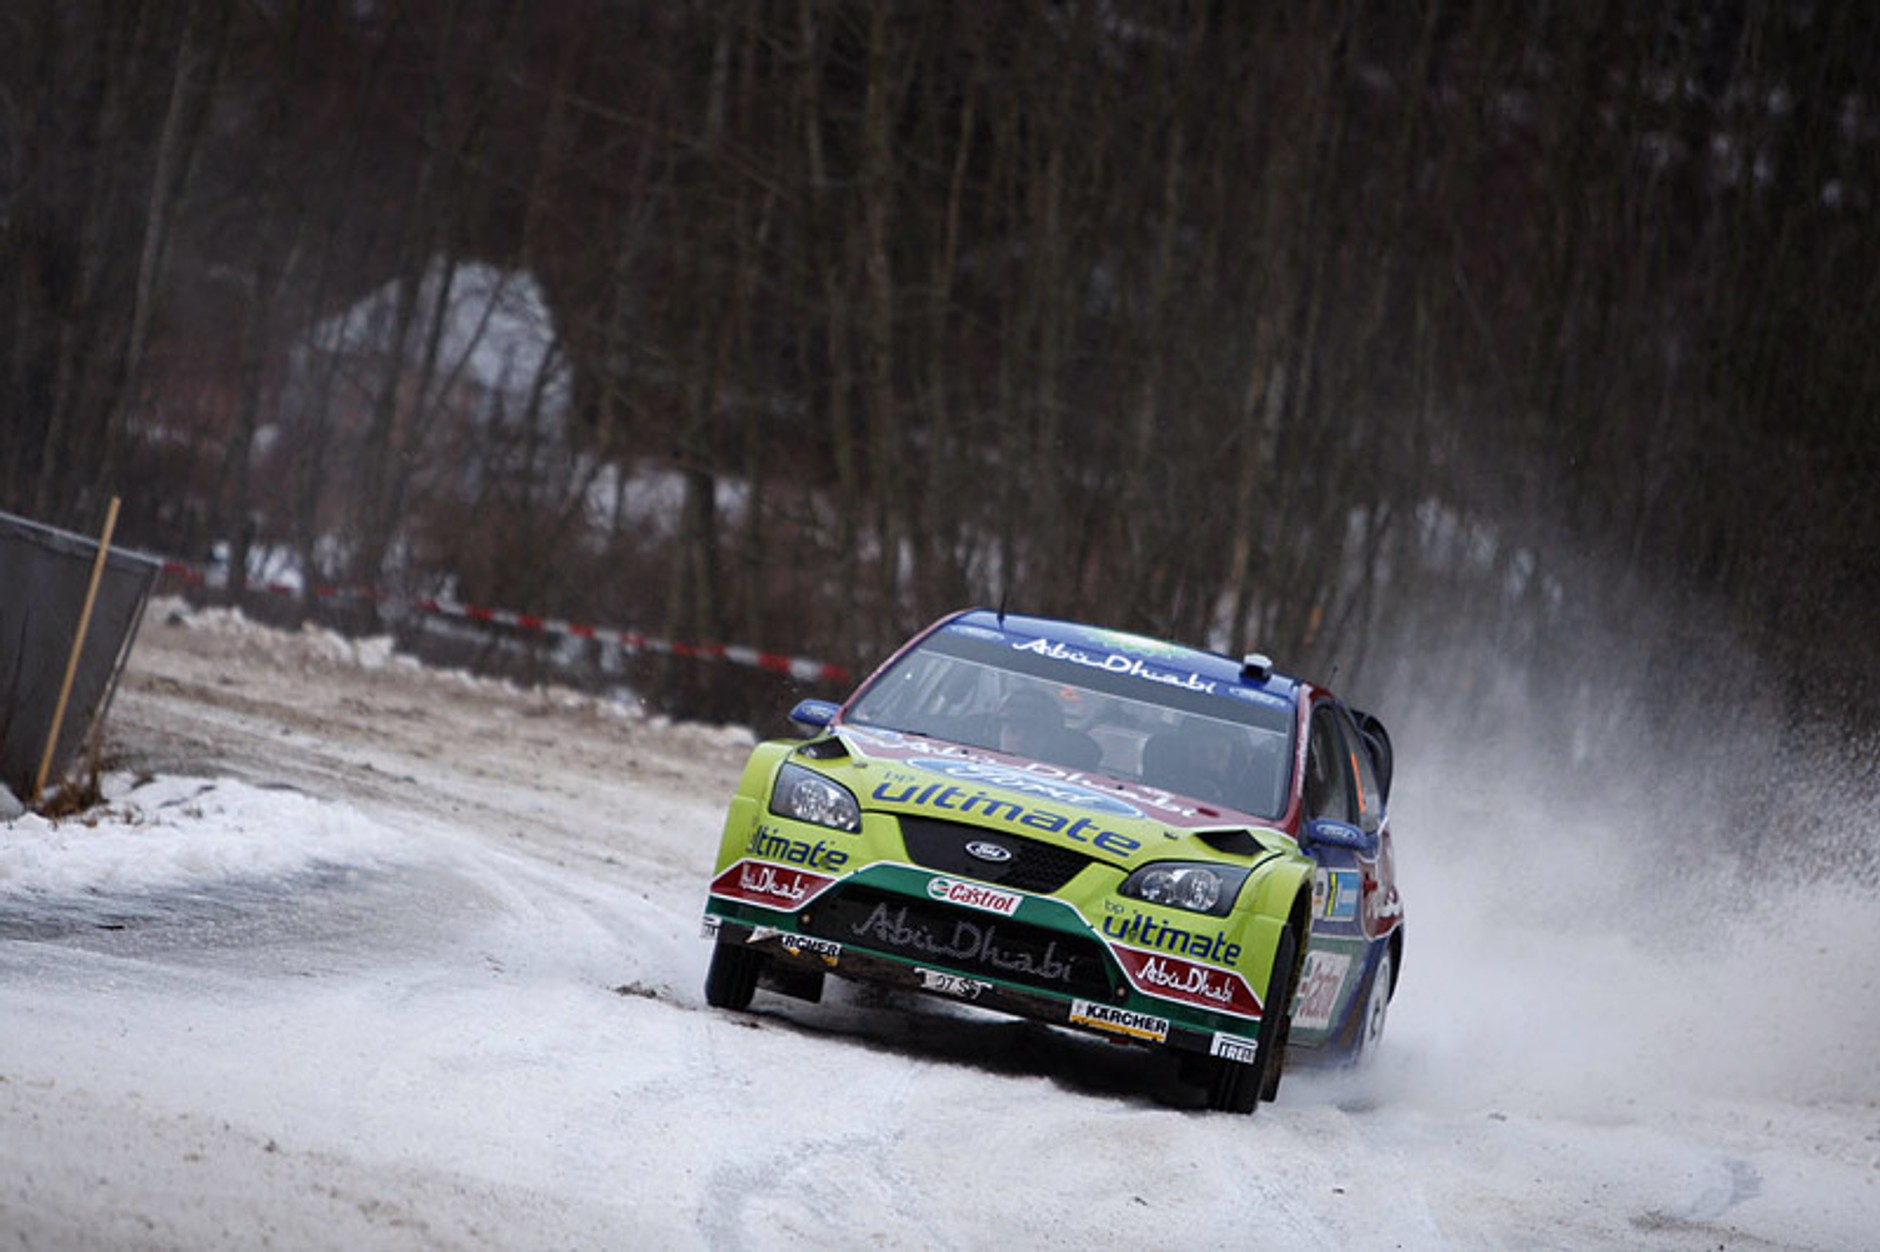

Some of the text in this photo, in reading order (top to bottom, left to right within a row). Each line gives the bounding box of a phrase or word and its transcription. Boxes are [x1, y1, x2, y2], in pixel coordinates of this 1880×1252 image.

[1012, 639, 1216, 693] Abu Dhabi
[872, 781, 1141, 857] ultimate
[949, 883, 1016, 912] Castrol
[851, 902, 1078, 982] Abu Dhabi
[1103, 912, 1242, 966] ultimate
[1135, 956, 1236, 1002] Abu Dhabi
